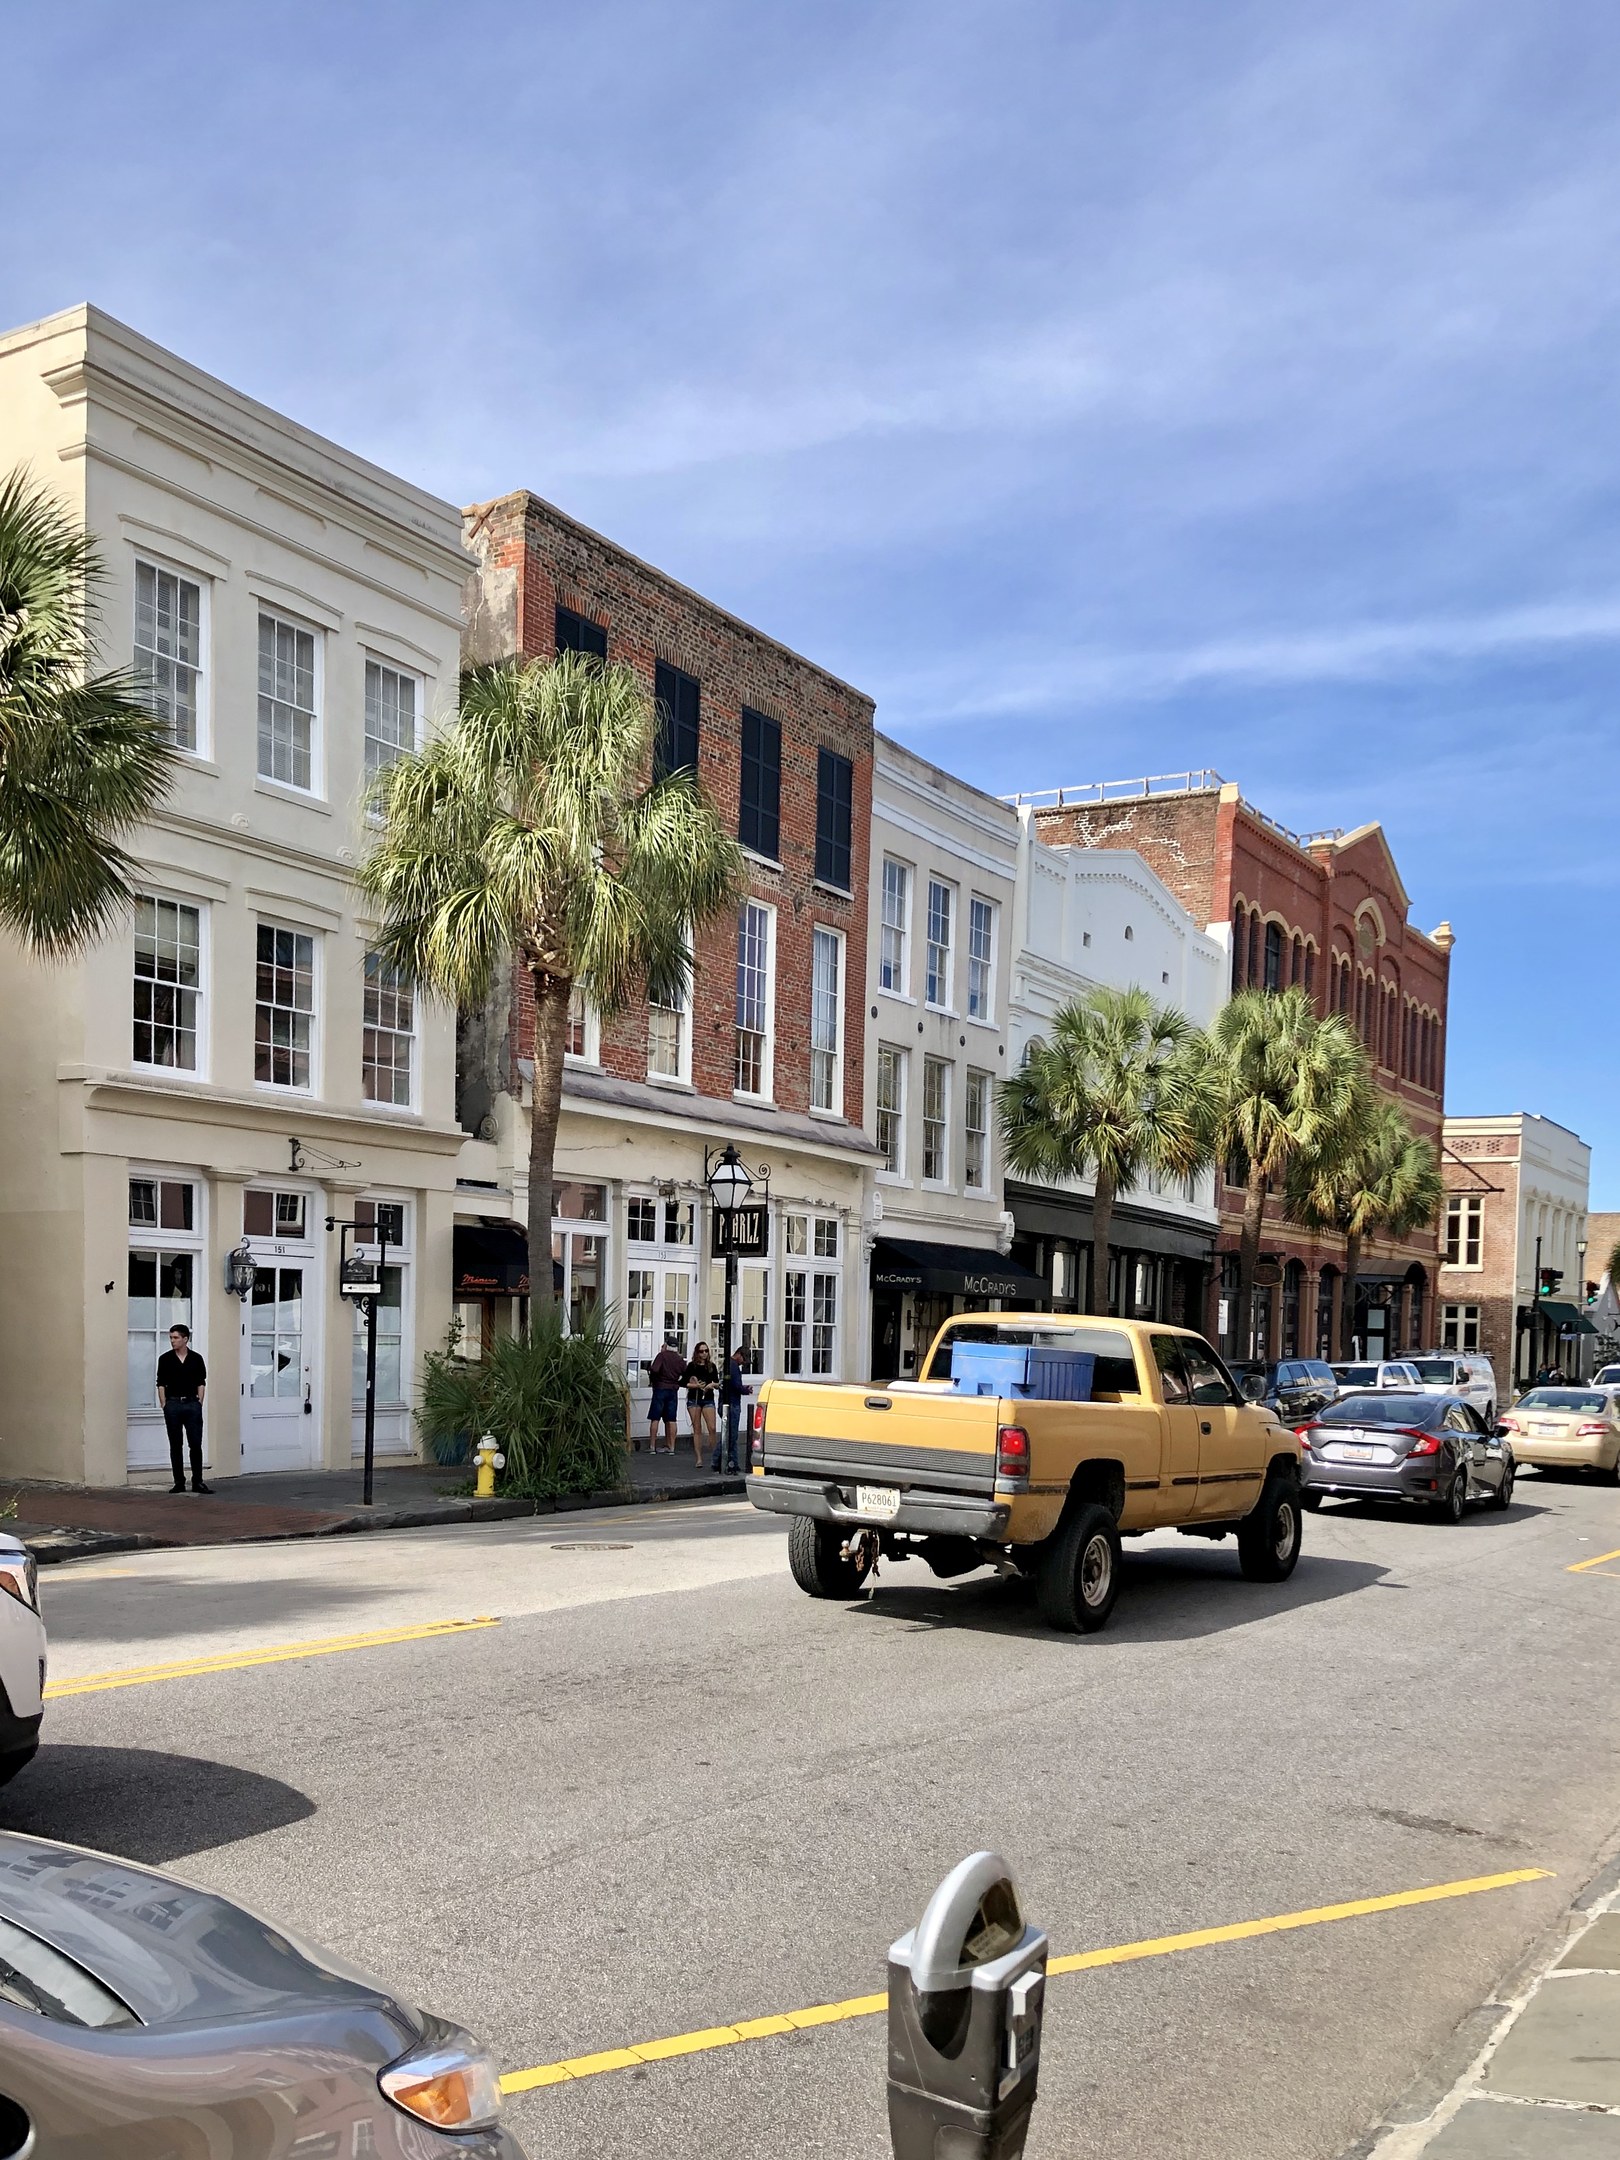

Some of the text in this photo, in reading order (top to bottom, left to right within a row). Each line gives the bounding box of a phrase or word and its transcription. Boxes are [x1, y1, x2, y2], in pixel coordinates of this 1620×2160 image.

[718, 1212, 760, 1245] PARLZ
[274, 1245, 286, 1254] 151
[861, 1492, 897, 1507] P628061
